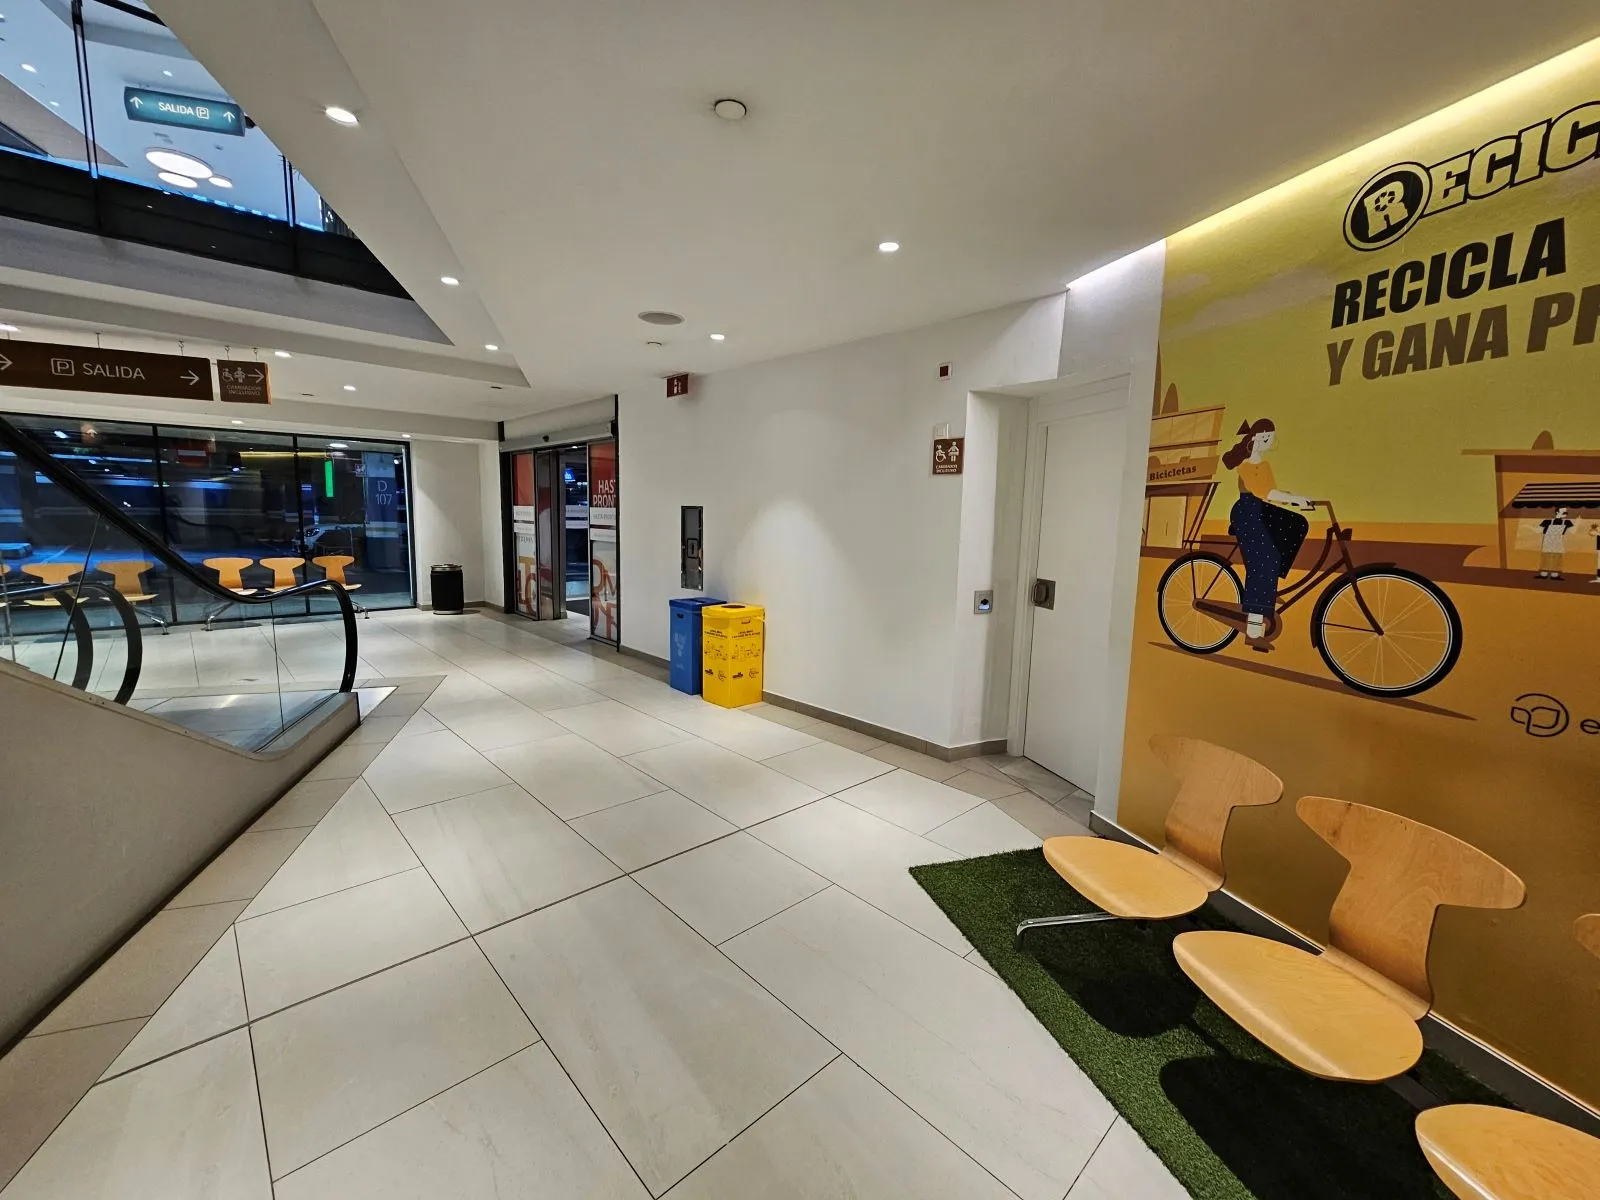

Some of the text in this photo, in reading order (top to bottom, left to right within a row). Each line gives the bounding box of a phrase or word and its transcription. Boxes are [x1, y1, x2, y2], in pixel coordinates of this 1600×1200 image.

[158, 102, 194, 115] SALIDA
[1330, 217, 1567, 329] RECICLA
[1326, 339, 1354, 386] Y
[1361, 304, 1509, 380] GANA
[82, 362, 145, 380] SALIDA
[1149, 465, 1197, 481] Bicicletas
[377, 480, 387, 492] D
[598, 479, 616, 494] HAS
[375, 493, 393, 505] 107
[592, 494, 616, 509] PRON
